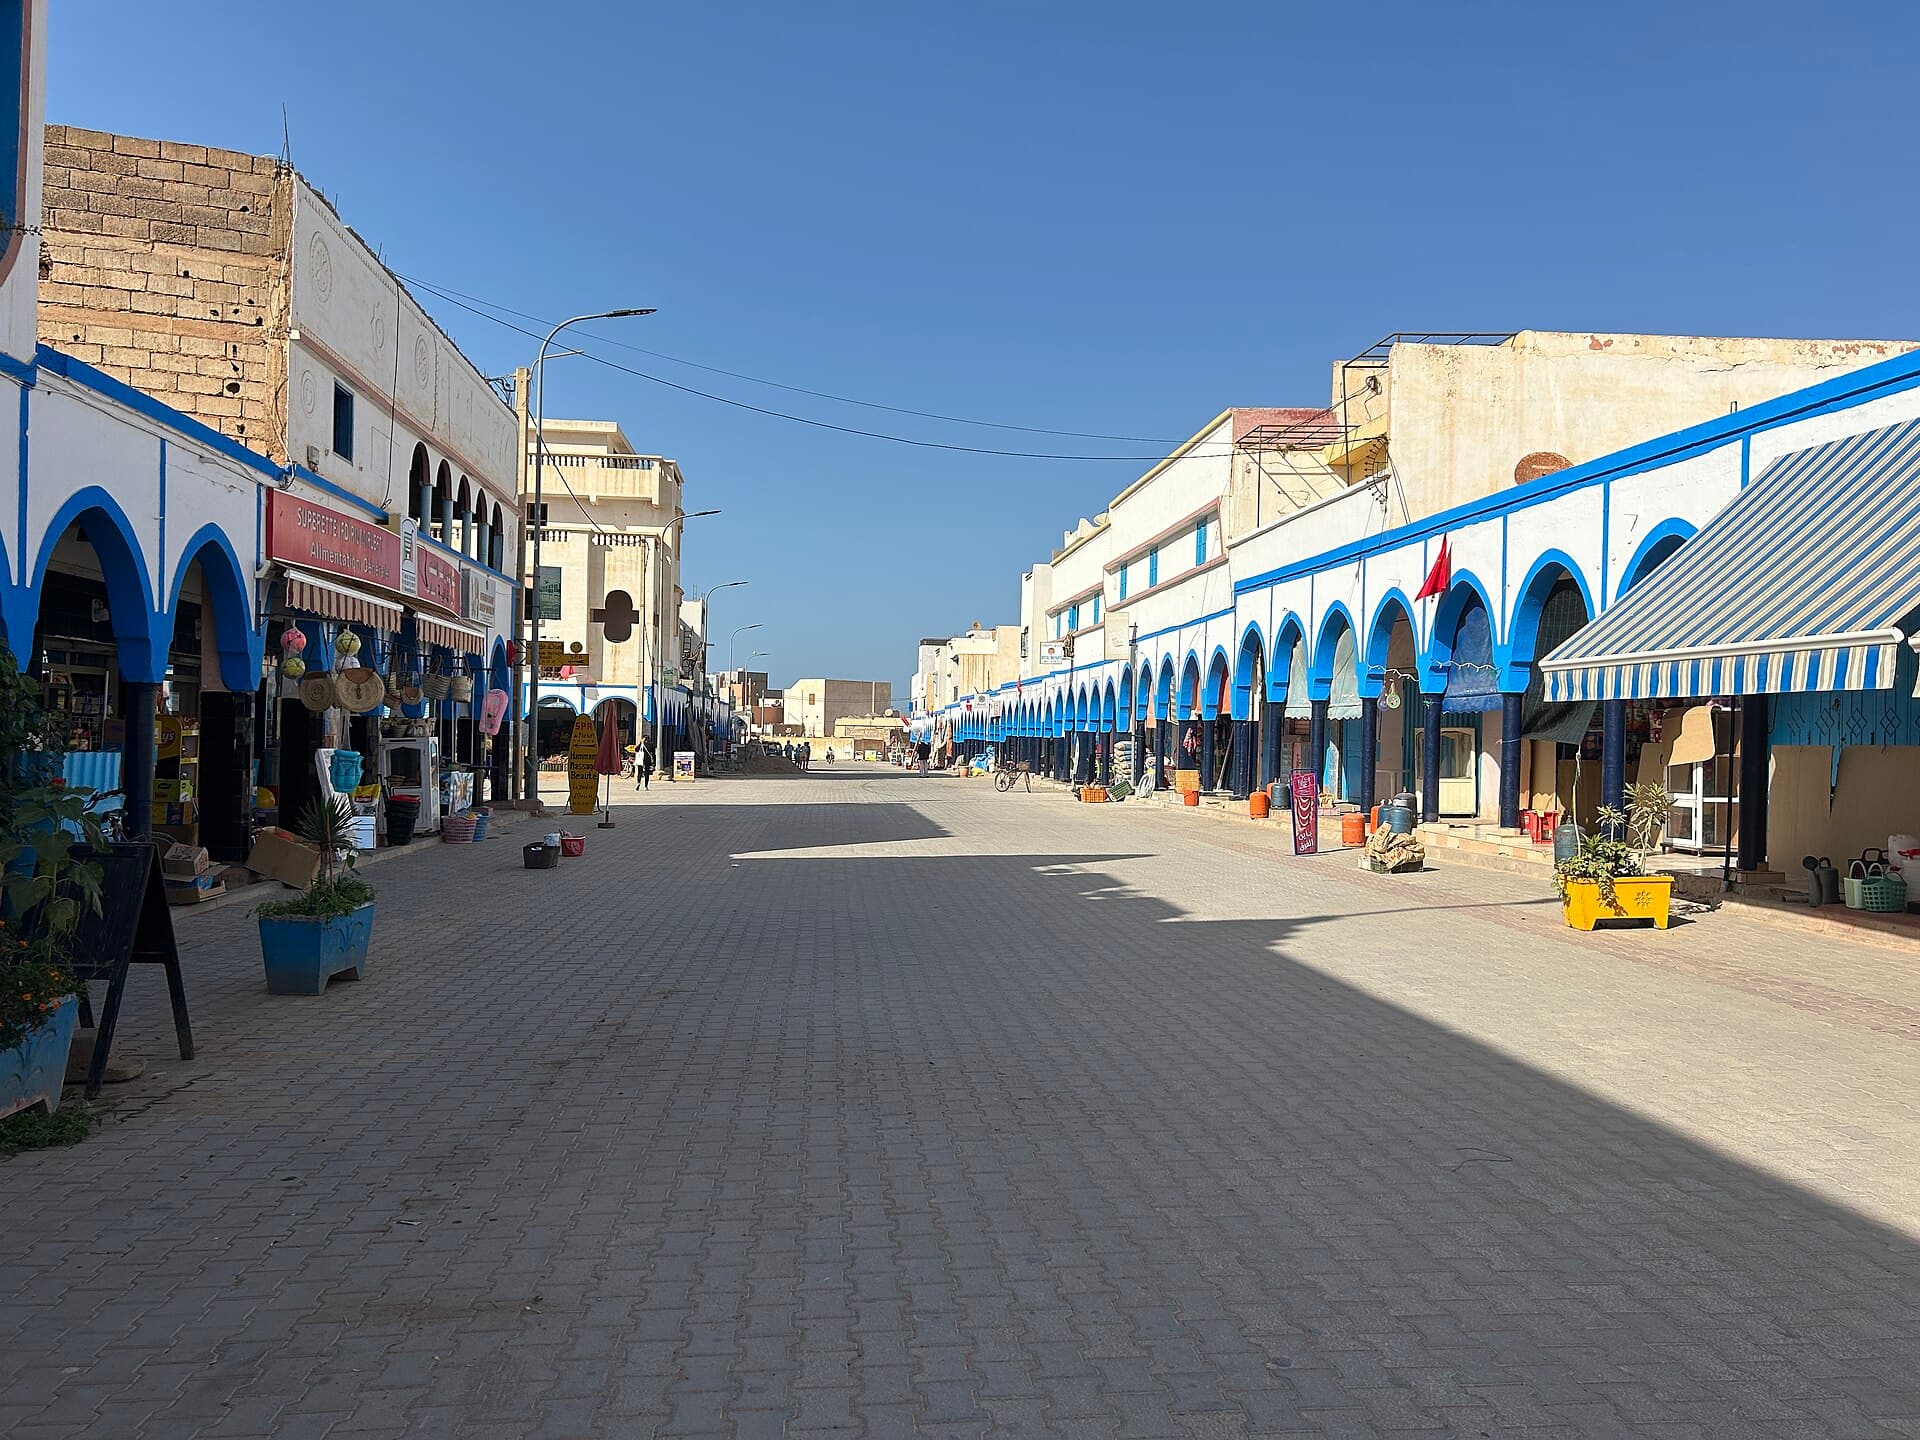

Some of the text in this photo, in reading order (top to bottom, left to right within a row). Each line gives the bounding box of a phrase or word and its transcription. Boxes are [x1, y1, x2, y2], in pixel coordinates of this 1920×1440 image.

[297, 507, 337, 537] SUPERETTE
[310, 541, 361, 572] Alimentation
[575, 722, 593, 732] SPA
